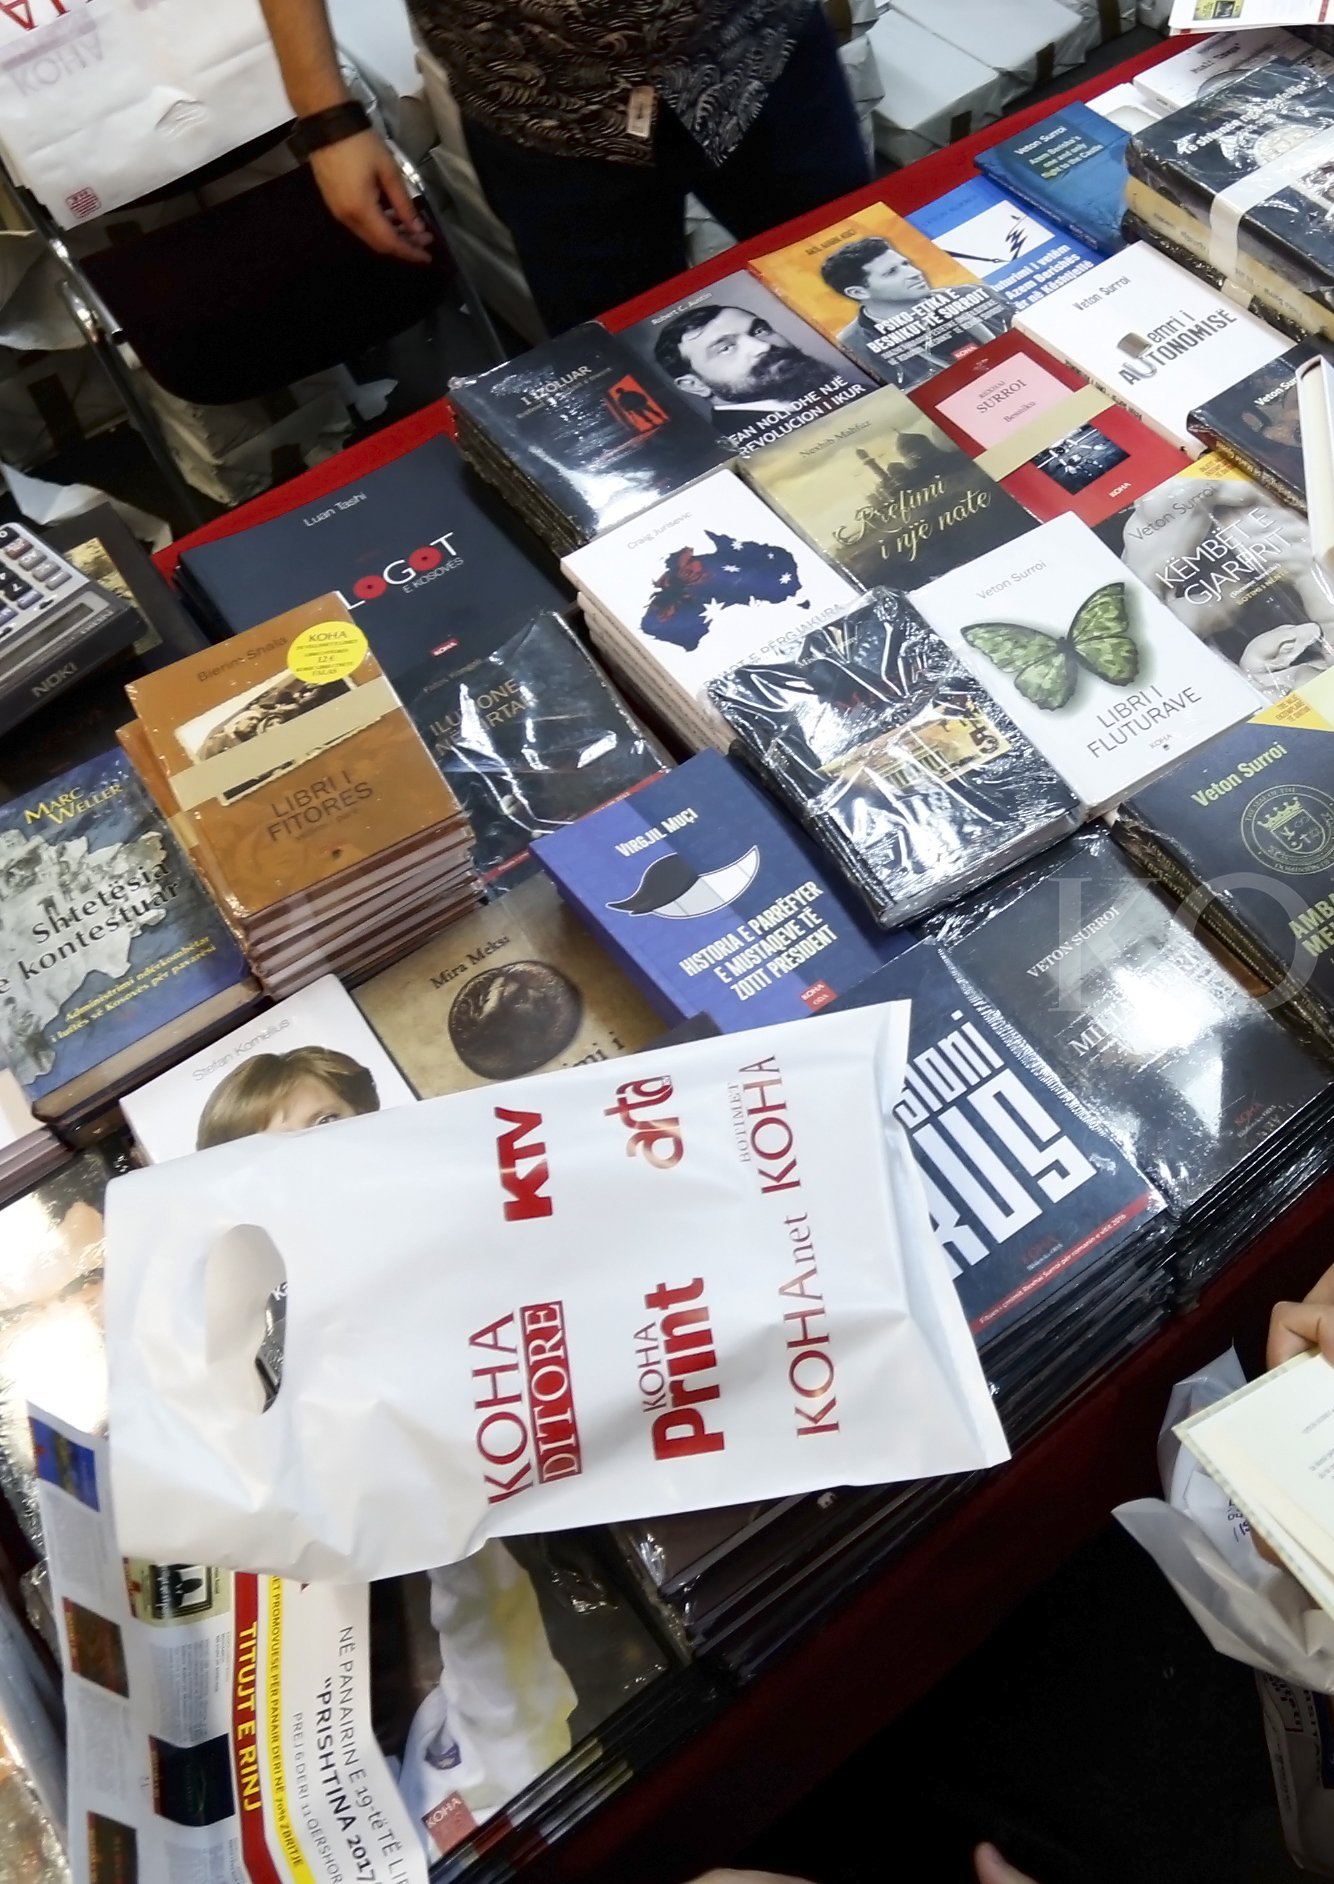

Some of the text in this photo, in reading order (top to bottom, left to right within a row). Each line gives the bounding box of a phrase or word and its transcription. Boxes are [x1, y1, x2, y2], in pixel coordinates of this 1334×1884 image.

[1014, 126, 1068, 155] Veton Surroi
[1004, 253, 1081, 300] Azem Berishës
[1038, 244, 1072, 266] vetëm
[1043, 259, 1095, 293] Kështjellë
[874, 287, 960, 334] PSIKO-ETIKA E
[940, 288, 991, 321] SURROIT
[1072, 275, 1132, 312] Veton Surroi
[1118, 308, 1237, 386] AUTONOMISË
[1147, 315, 1185, 344] emri
[739, 383, 866, 459] REVOLUCION IKUR
[757, 407, 790, 430] NOLI
[788, 391, 821, 415] DHE
[819, 375, 848, 396] NJË
[976, 379, 1027, 414] SURROI
[1254, 384, 1284, 407] Veton
[303, 491, 367, 527] Luan Tashi
[1109, 482, 1132, 498] KOHA
[627, 531, 654, 550] Craig
[897, 519, 934, 562] një
[1128, 511, 1174, 541] Veton
[1155, 508, 1275, 589] KËMBËT E
[334, 532, 457, 610] LOGOT
[976, 561, 1047, 600] Veton Surroi
[308, 631, 348, 642] KOHA
[1087, 687, 1202, 758] FLUTURAVE
[1096, 691, 1153, 729] LIBRI
[54, 783, 124, 825] WELLER
[269, 773, 340, 818] LIBRI
[1191, 772, 1243, 808] Veton
[1237, 741, 1288, 779] Surroi
[23, 786, 83, 825] MARC
[265, 783, 375, 843] FITORES
[614, 807, 698, 857] VIRGJIL MUÇI
[18, 881, 180, 981] kontestuar
[32, 858, 171, 944] Shtetësia
[679, 880, 825, 977] HISTORIA E PARRËFYER
[430, 933, 511, 989] Mira Meksi
[714, 906, 824, 984] E MUSTAQEVE TË
[729, 927, 839, 1001] ZOTIT PRESIDENT
[1026, 906, 1121, 979] VETON SURROI
[192, 1017, 291, 1082] Stefan Kornelius
[727, 1082, 752, 1164] BOTIMET
[739, 1053, 802, 1196] KOHA
[494, 1107, 553, 1222] KTV
[778, 1211, 841, 1438] KOHAnet
[519, 1301, 582, 1485] DITORE
[633, 1321, 668, 1413] KOHA
[645, 1276, 725, 1462] Print
[469, 1311, 535, 1505] KOHA
[269, 1597, 282, 1674] PROMOVUESE
[237, 1621, 263, 1812] TITUJT E RINJ
[338, 1626, 402, 1858] NË PANAIRIN E 19-të TË
[292, 1711, 309, 1801] PREJ DERI
[424, 1793, 462, 1829] KOHA
